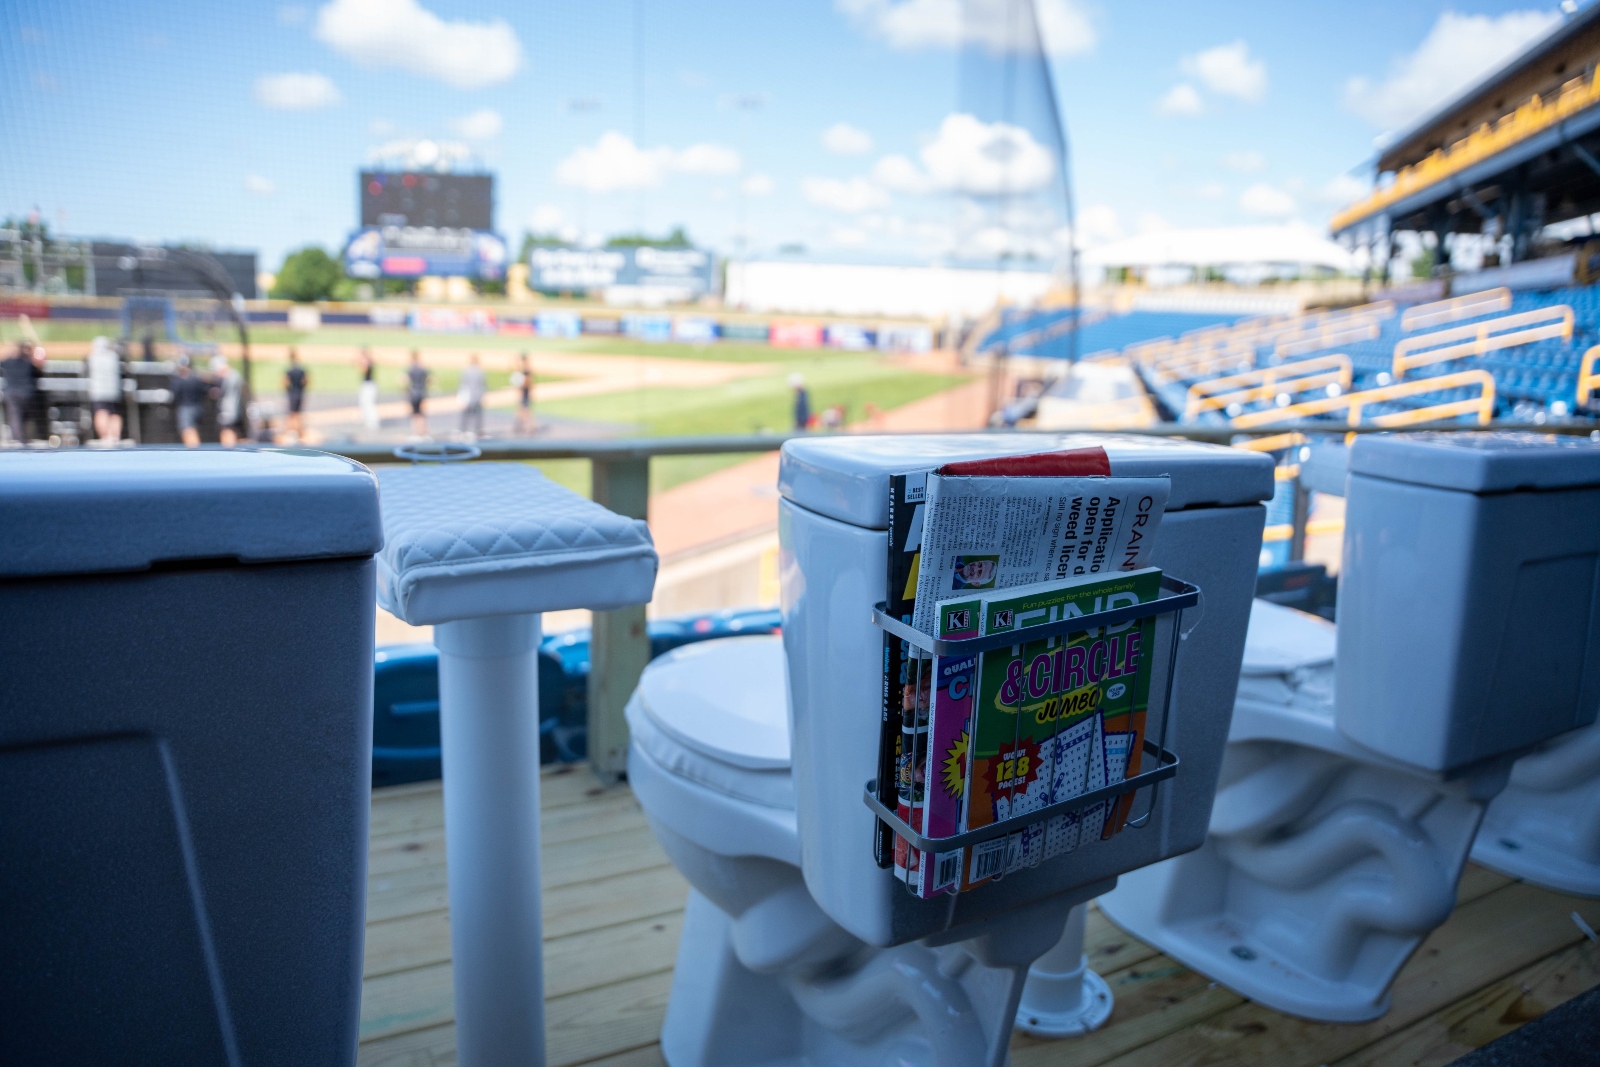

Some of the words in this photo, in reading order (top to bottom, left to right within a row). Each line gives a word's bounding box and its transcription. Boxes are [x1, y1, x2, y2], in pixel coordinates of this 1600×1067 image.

[1058, 496, 1067, 511] Still
[1055, 512, 1063, 522] no
[1064, 496, 1083, 540] weed
[1082, 496, 1101, 536] open
[1051, 522, 1062, 538] sign
[1090, 497, 1121, 573] Applicatio
[1121, 496, 1153, 572] CRAIN'
[1047, 538, 1058, 558] when
[1077, 539, 1094, 562] for
[1044, 559, 1053, 571] rec
[1056, 545, 1076, 580] licen
[1073, 565, 1086, 576] d
[1043, 572, 1051, 582] sa
[1022, 601, 1037, 610] Fun
[1037, 596, 1065, 608] puzzles
[1066, 592, 1078, 601] for
[1079, 590, 1092, 599] the
[1092, 586, 1113, 597] whole
[1113, 581, 1136, 593] family!
[949, 612, 964, 630] K
[994, 612, 1008, 628] K
[1037, 690, 1100, 721] JUMBO
[1002, 748, 1027, 761] WOW!
[995, 756, 1030, 783] 128
[997, 776, 1026, 790] PAGES!
